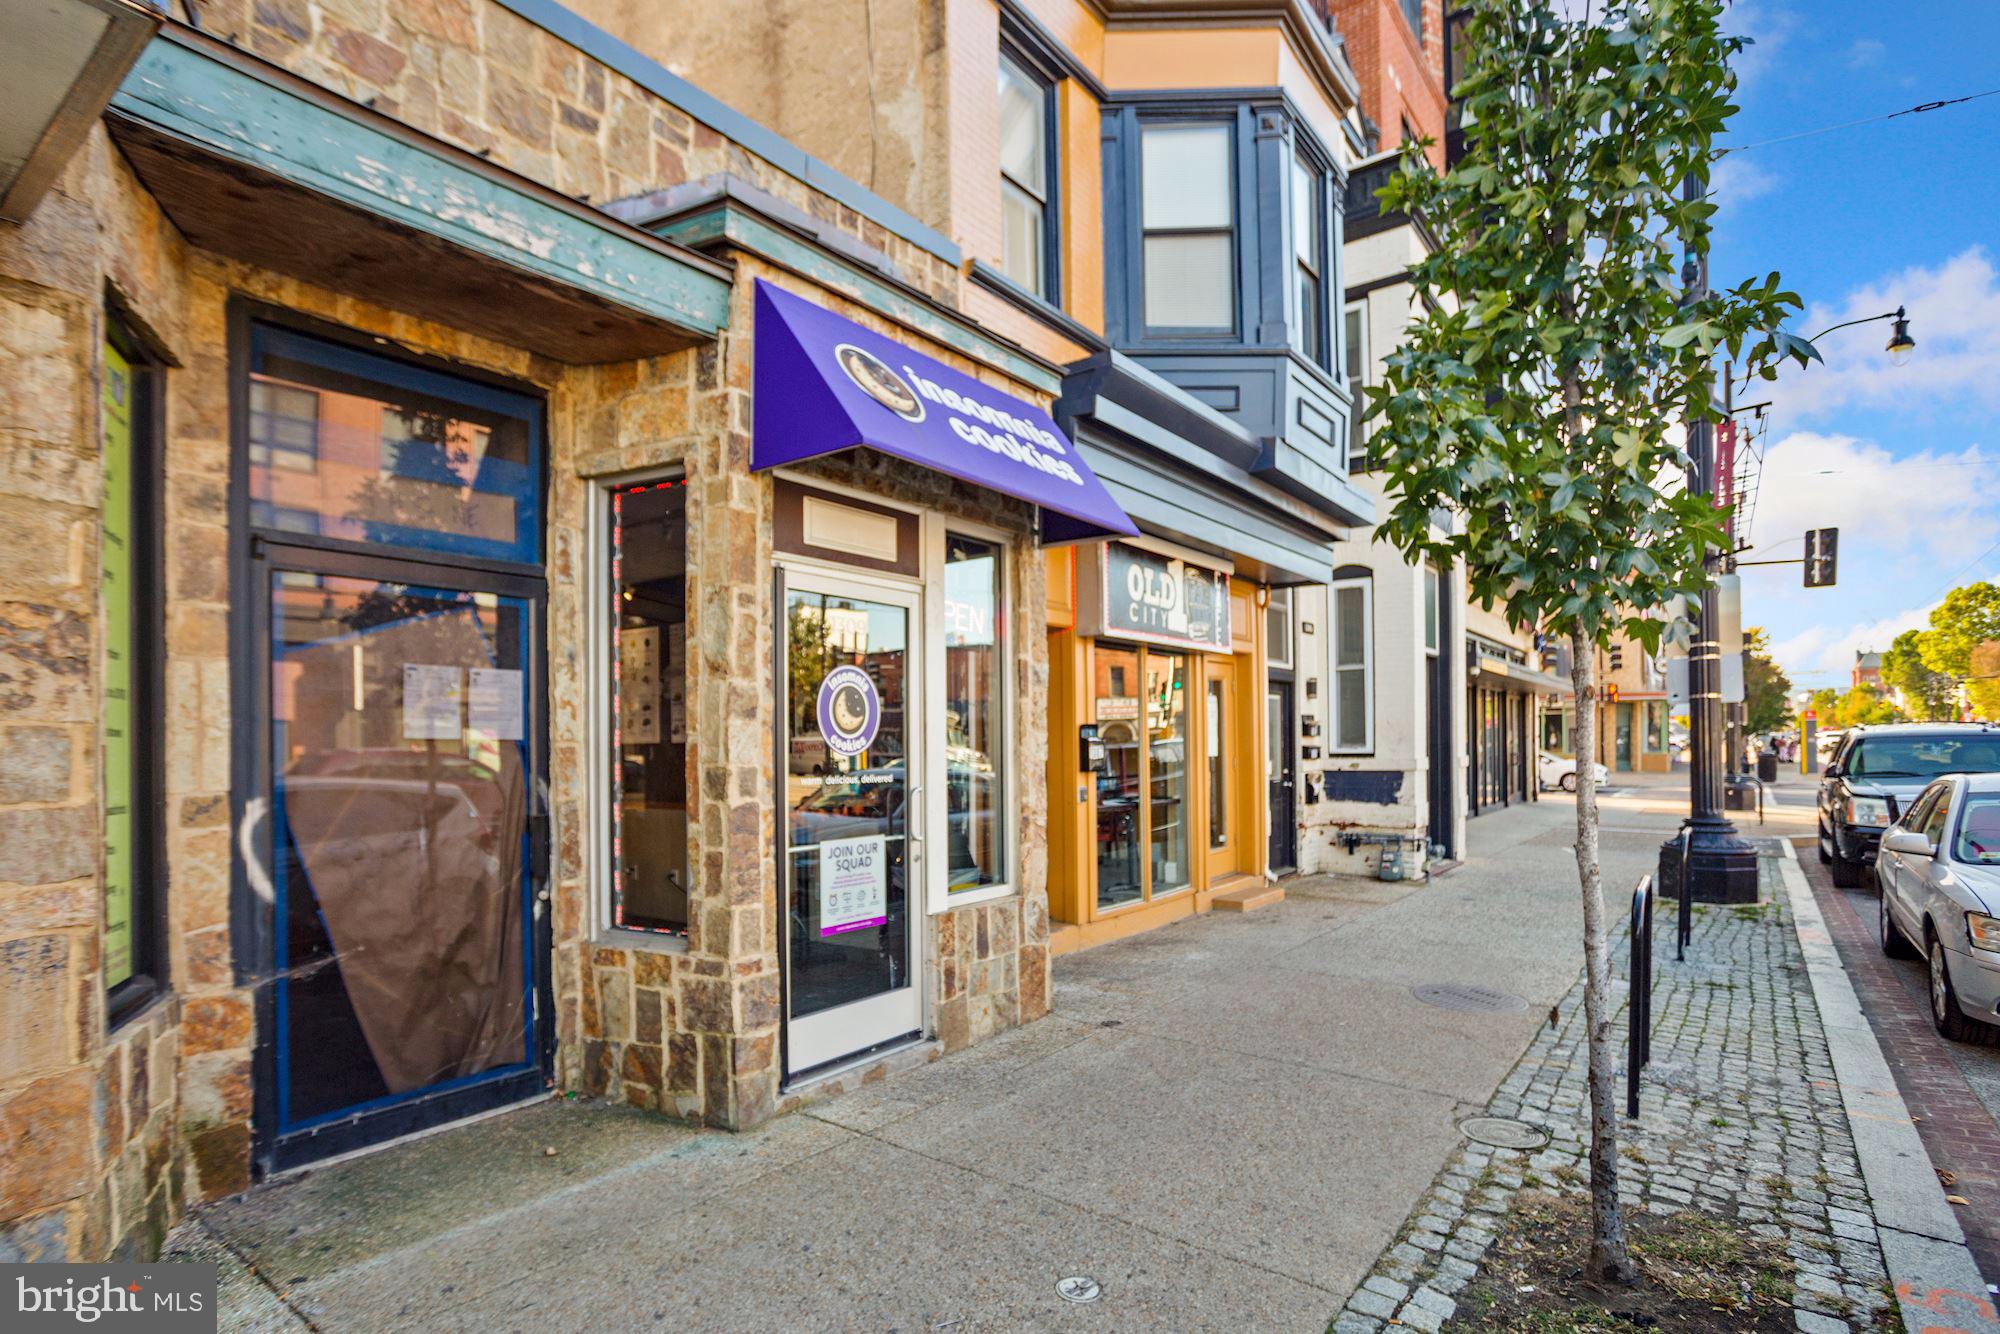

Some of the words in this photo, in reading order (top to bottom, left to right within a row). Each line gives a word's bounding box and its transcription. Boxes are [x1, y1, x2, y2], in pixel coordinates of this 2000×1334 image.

[902, 365, 1066, 455] insomnia
[949, 417, 1084, 486] cookies
[1127, 563, 1176, 610] OLD
[944, 599, 984, 634] PEN
[1129, 602, 1168, 628] CITY
[830, 734, 867, 753] cookies
[828, 846, 853, 859] JOIN
[856, 843, 878, 855] OUR
[836, 857, 872, 872] SQUAD
